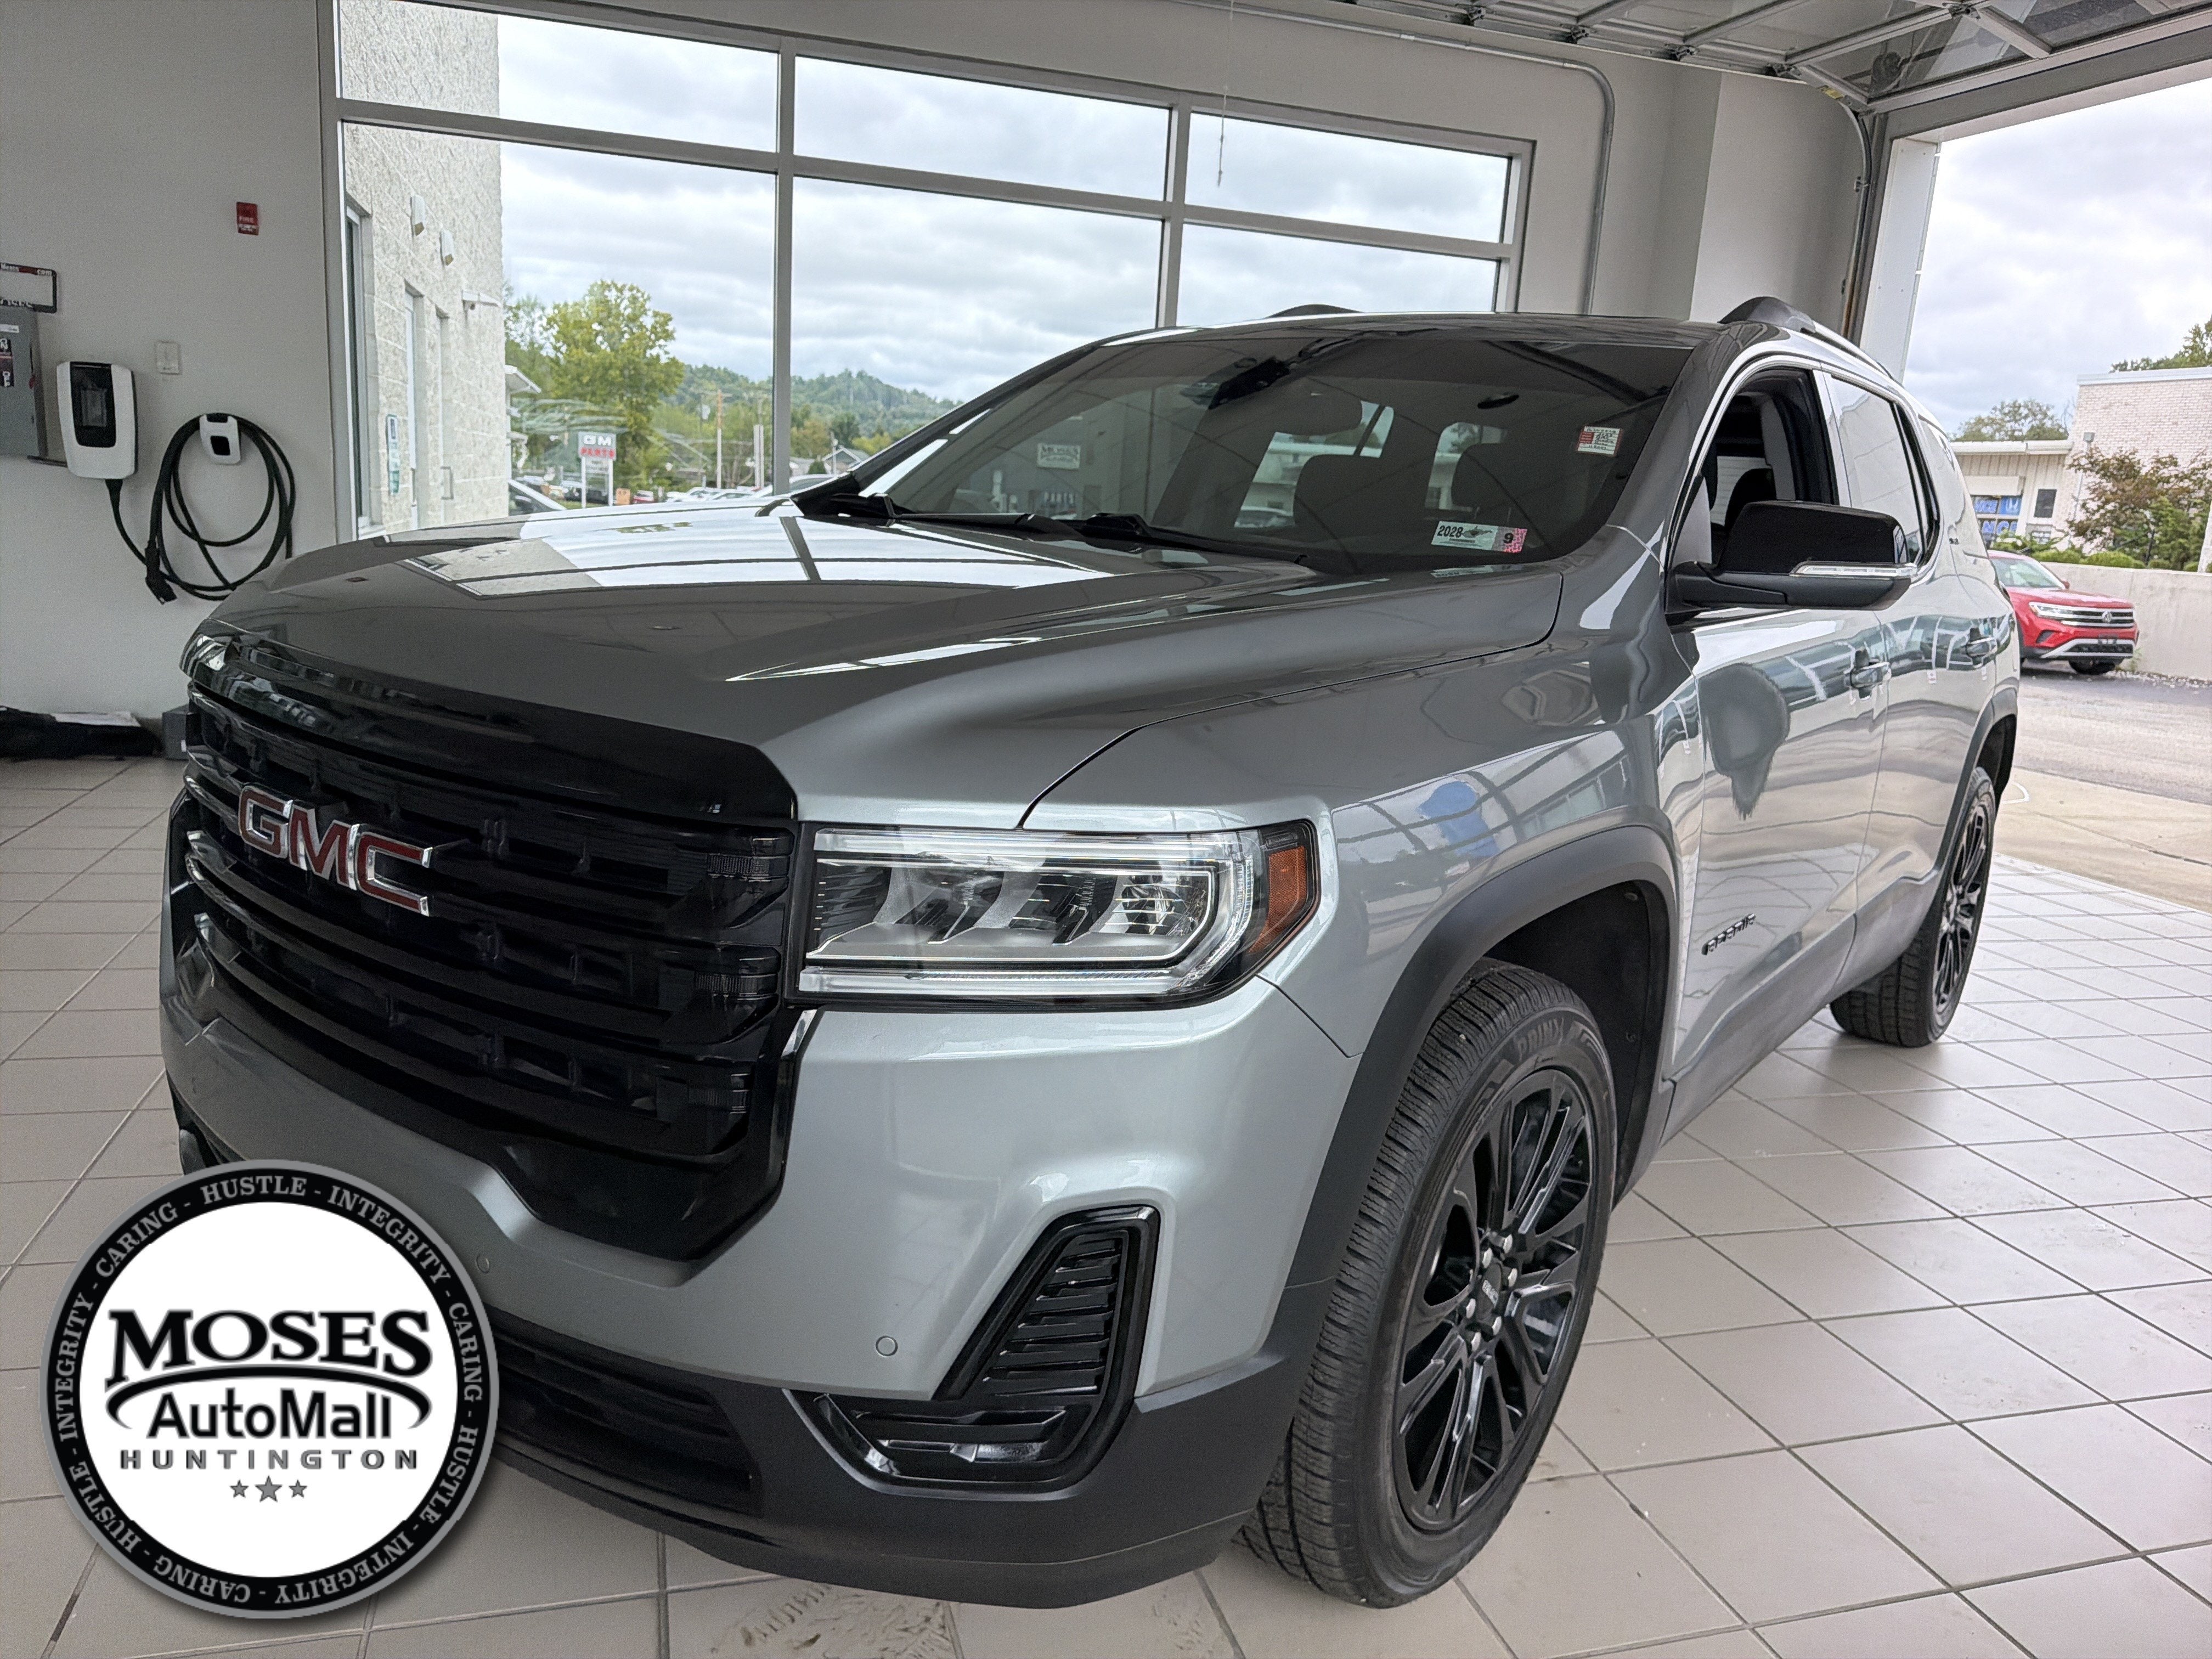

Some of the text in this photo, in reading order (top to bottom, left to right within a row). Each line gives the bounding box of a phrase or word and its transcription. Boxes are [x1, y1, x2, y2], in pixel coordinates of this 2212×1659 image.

[583, 435, 612, 446] GM
[1437, 525, 1464, 538] 2028
[1503, 533, 1514, 544] 9
[238, 785, 433, 917] GMC
